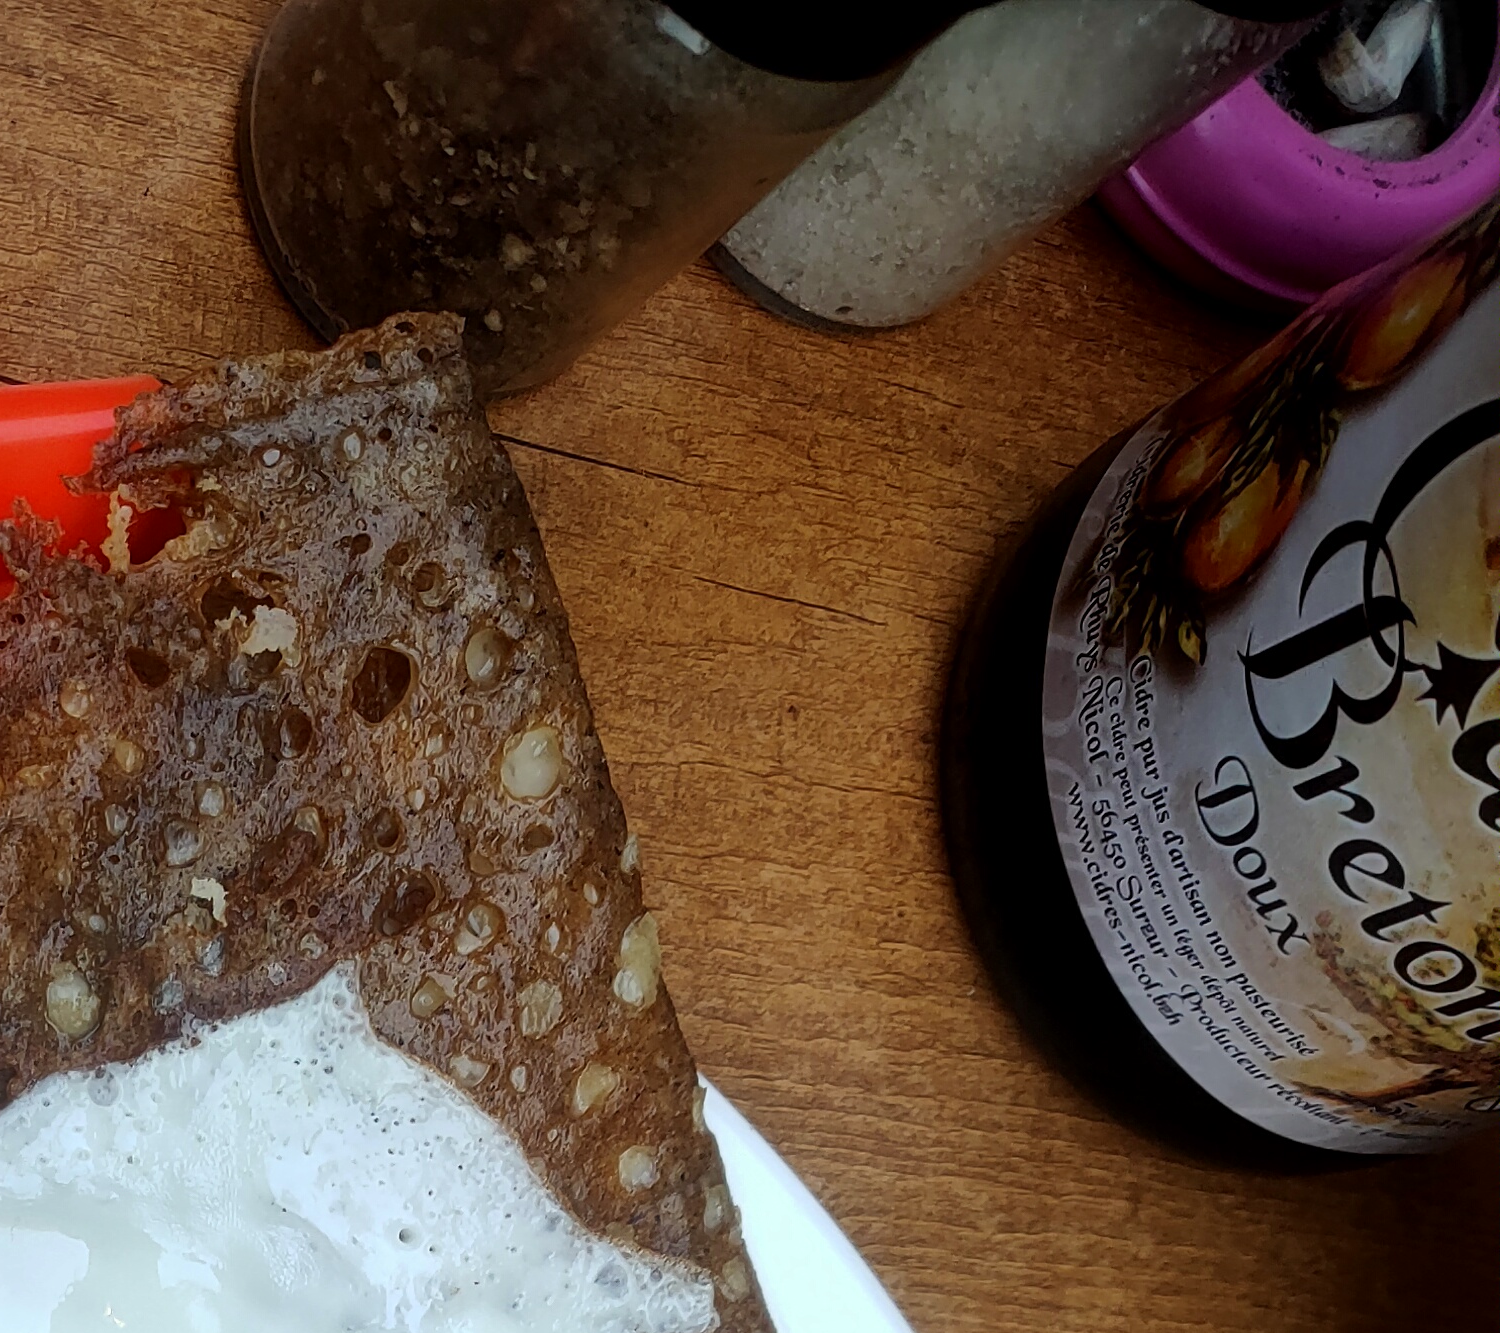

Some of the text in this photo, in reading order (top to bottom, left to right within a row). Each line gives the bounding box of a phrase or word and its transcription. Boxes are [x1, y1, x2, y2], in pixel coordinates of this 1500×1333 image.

[1097, 543, 1118, 574] de
[1077, 575, 1114, 673] Rhuys
[1078, 675, 1109, 764] Nicol
[1130, 655, 1153, 730] Cidre
[1134, 737, 1159, 780] pur
[1092, 799, 1126, 869] 56450
[1141, 786, 1169, 823] jus
[1105, 676, 1286, 1062] Ce cidre peut présenter un léger dépôt naturel
[1195, 755, 1310, 956] Doux
[1068, 782, 1184, 1026] www.cidres-nicol.bzh
[1206, 931, 1236, 968] non
[1170, 984, 1271, 1082] Producteur
[1226, 972, 1319, 1056] pasteurisé
